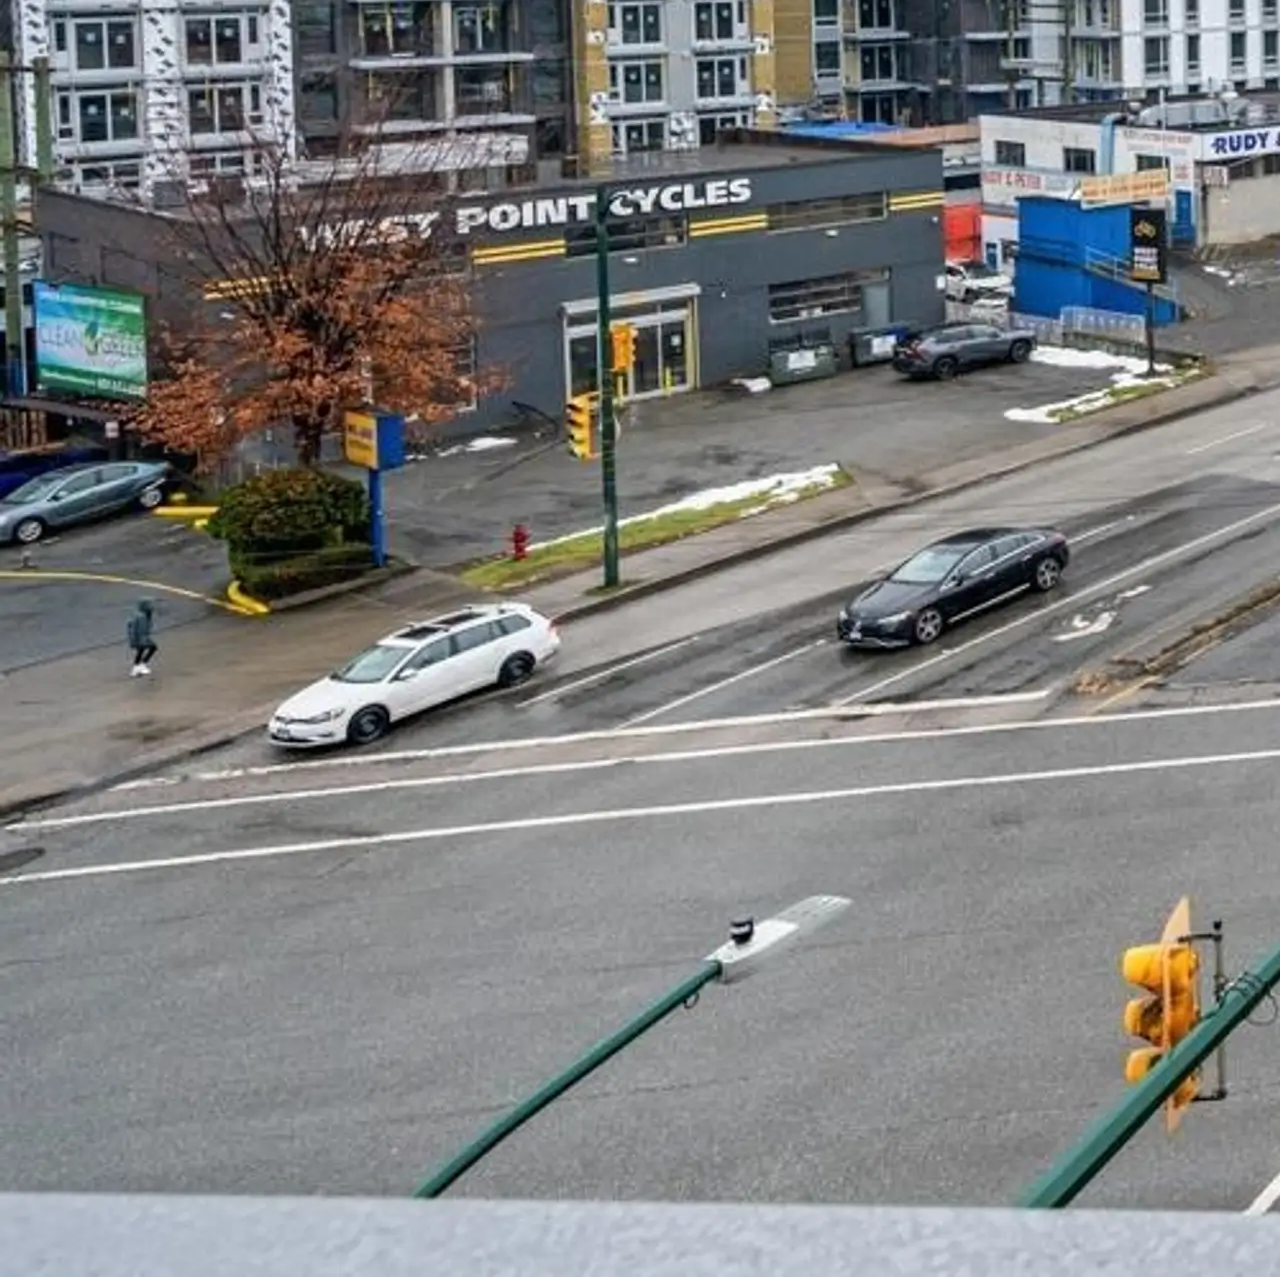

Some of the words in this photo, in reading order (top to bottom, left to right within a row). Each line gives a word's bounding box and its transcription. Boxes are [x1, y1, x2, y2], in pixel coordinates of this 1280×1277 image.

[1211, 130, 1270, 155] RUDY
[457, 193, 597, 234] POINT
[608, 177, 752, 217] CYCLES
